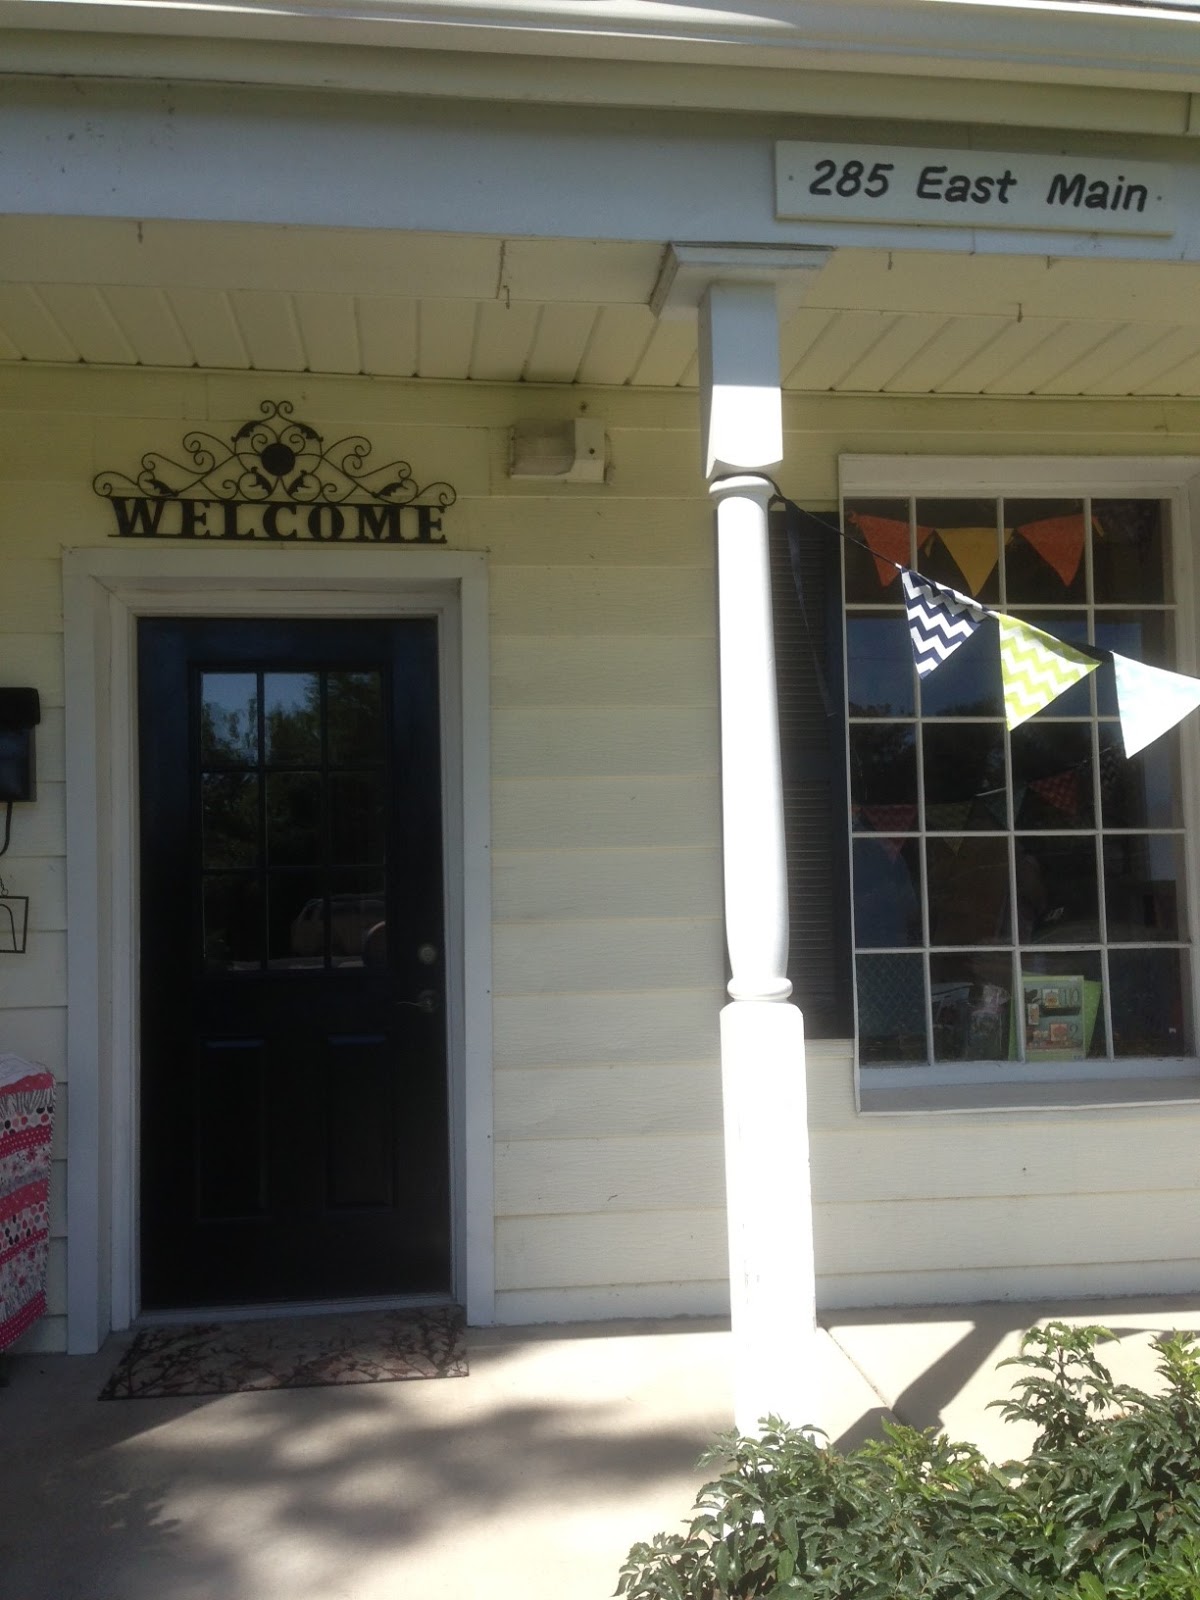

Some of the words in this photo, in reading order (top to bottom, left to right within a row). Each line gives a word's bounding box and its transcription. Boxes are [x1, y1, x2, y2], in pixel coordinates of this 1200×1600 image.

[809, 159, 894, 197] 285
[916, 165, 1017, 205] East
[1046, 173, 1148, 212] Main
[110, 498, 447, 543] WELCOME
